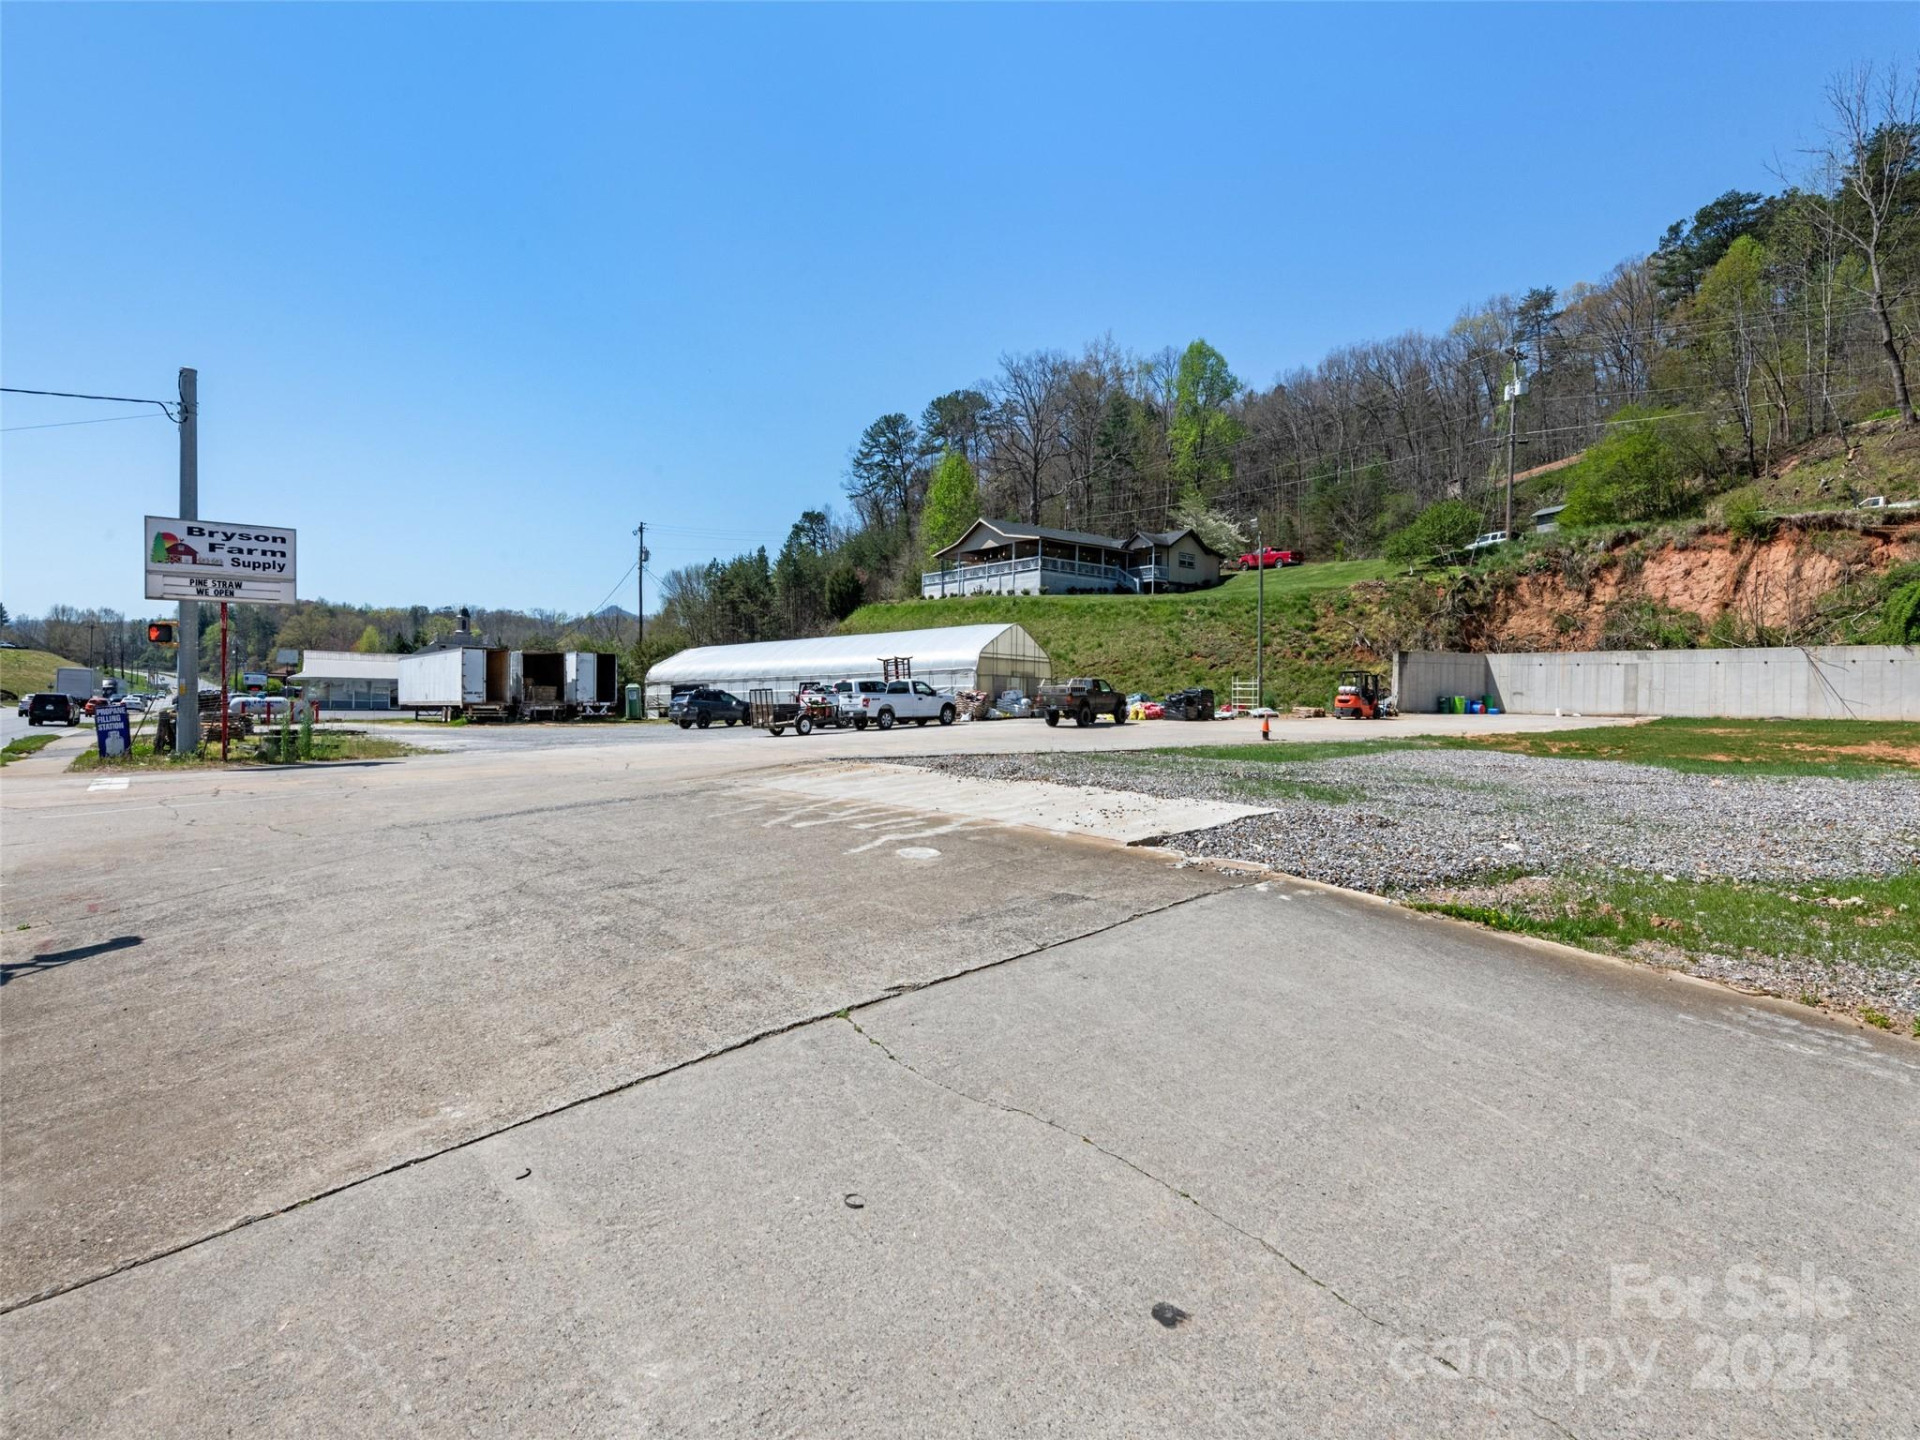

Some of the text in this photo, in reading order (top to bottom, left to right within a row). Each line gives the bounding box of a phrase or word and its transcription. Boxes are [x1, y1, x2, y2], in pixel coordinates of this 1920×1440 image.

[187, 526, 287, 544] Bryson
[208, 543, 287, 558] Farm
[231, 557, 286, 572] Supply
[190, 578, 243, 589] PINE STRAW
[196, 588, 235, 597] WE OPEN
[96, 707, 125, 715] PROPANE
[98, 715, 121, 723] FILLING
[98, 722, 123, 730] STATION
